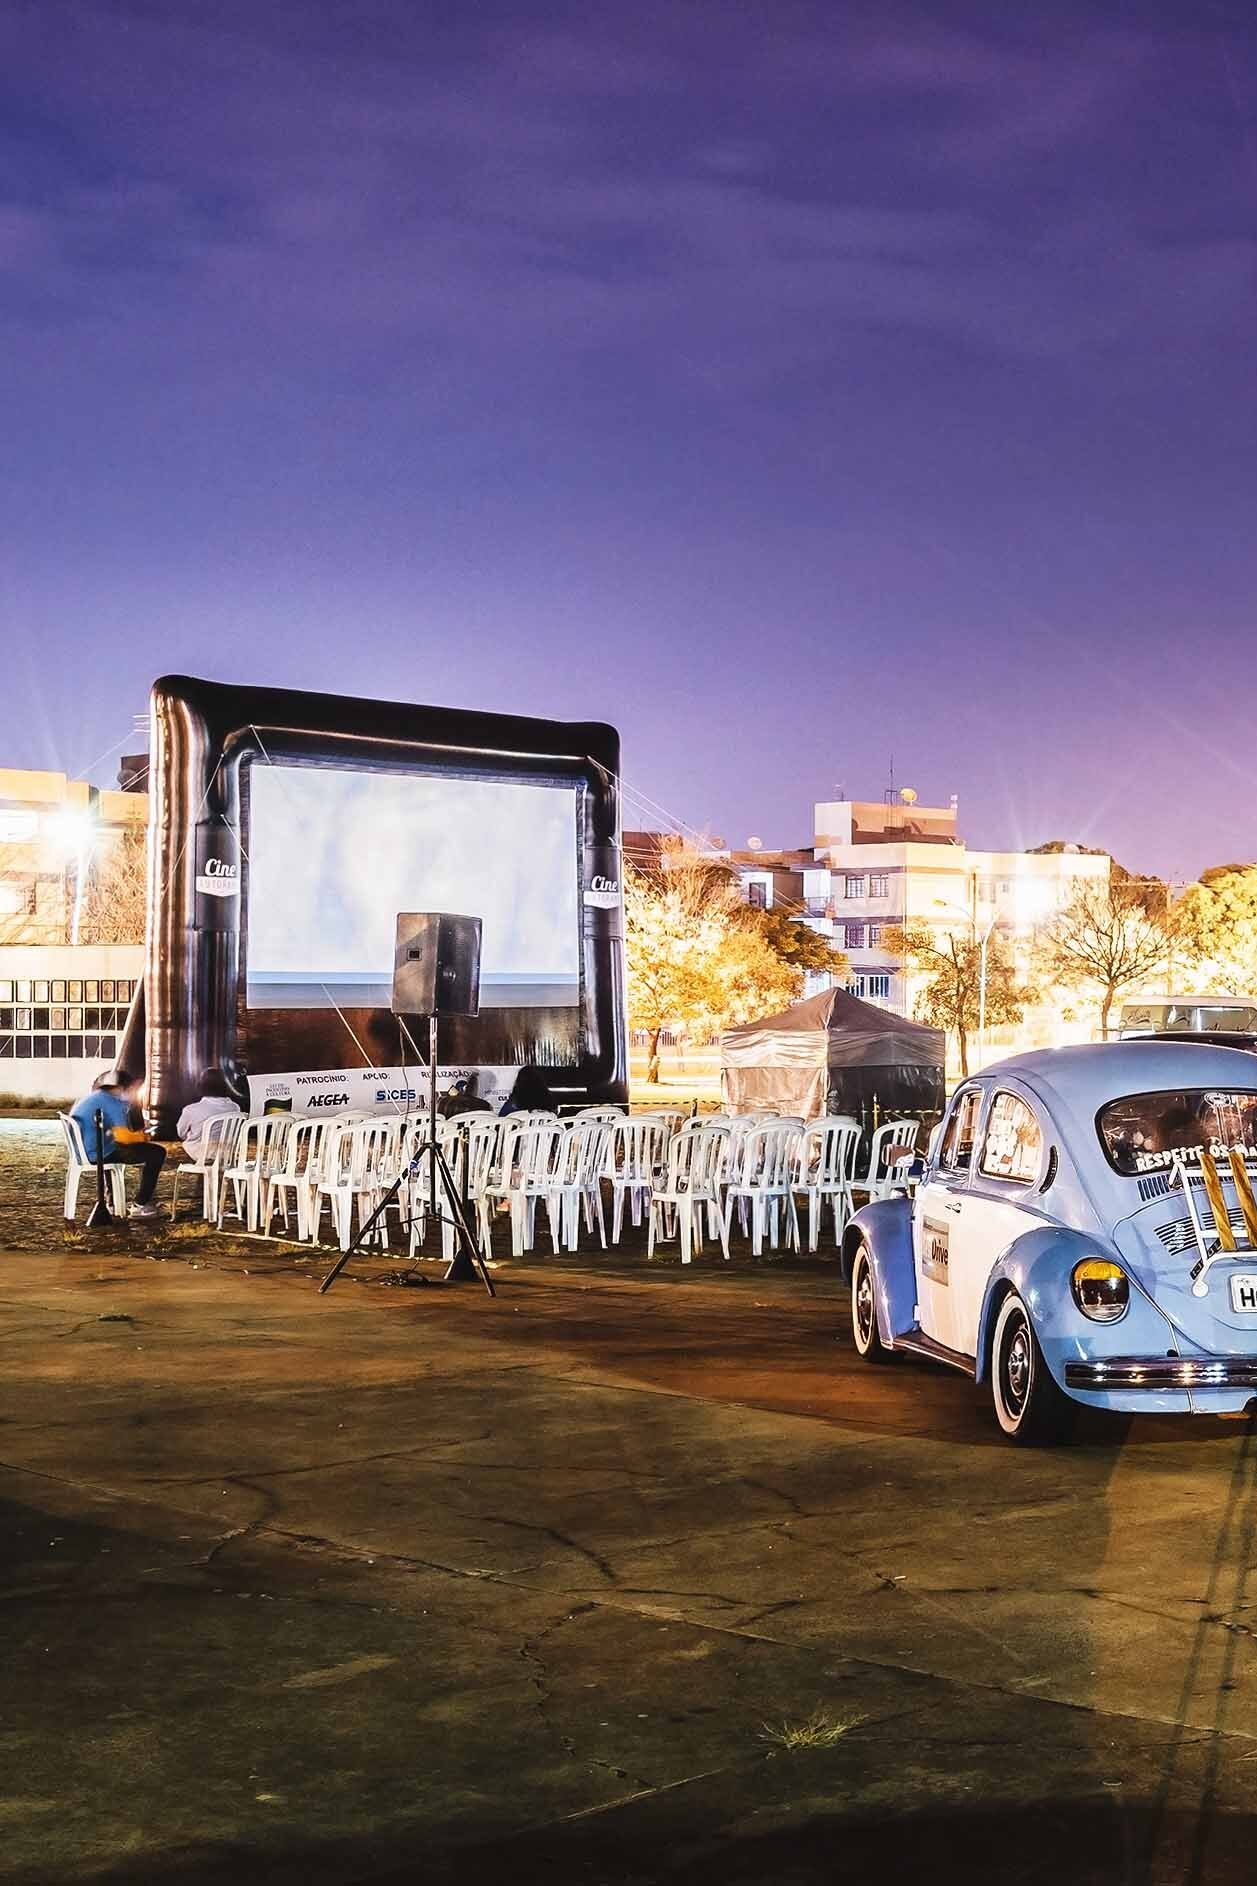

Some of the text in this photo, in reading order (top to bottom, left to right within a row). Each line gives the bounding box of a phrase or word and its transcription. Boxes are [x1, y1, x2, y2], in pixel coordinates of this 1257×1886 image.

[205, 858, 237, 877] Cine
[591, 875, 618, 892] Cine
[296, 1074, 349, 1085] PATROCÍNIO:
[421, 1069, 473, 1080] RLIZAÇÃO:
[307, 1093, 350, 1108] AEGEA
[1209, 1144, 1229, 1159] OS
